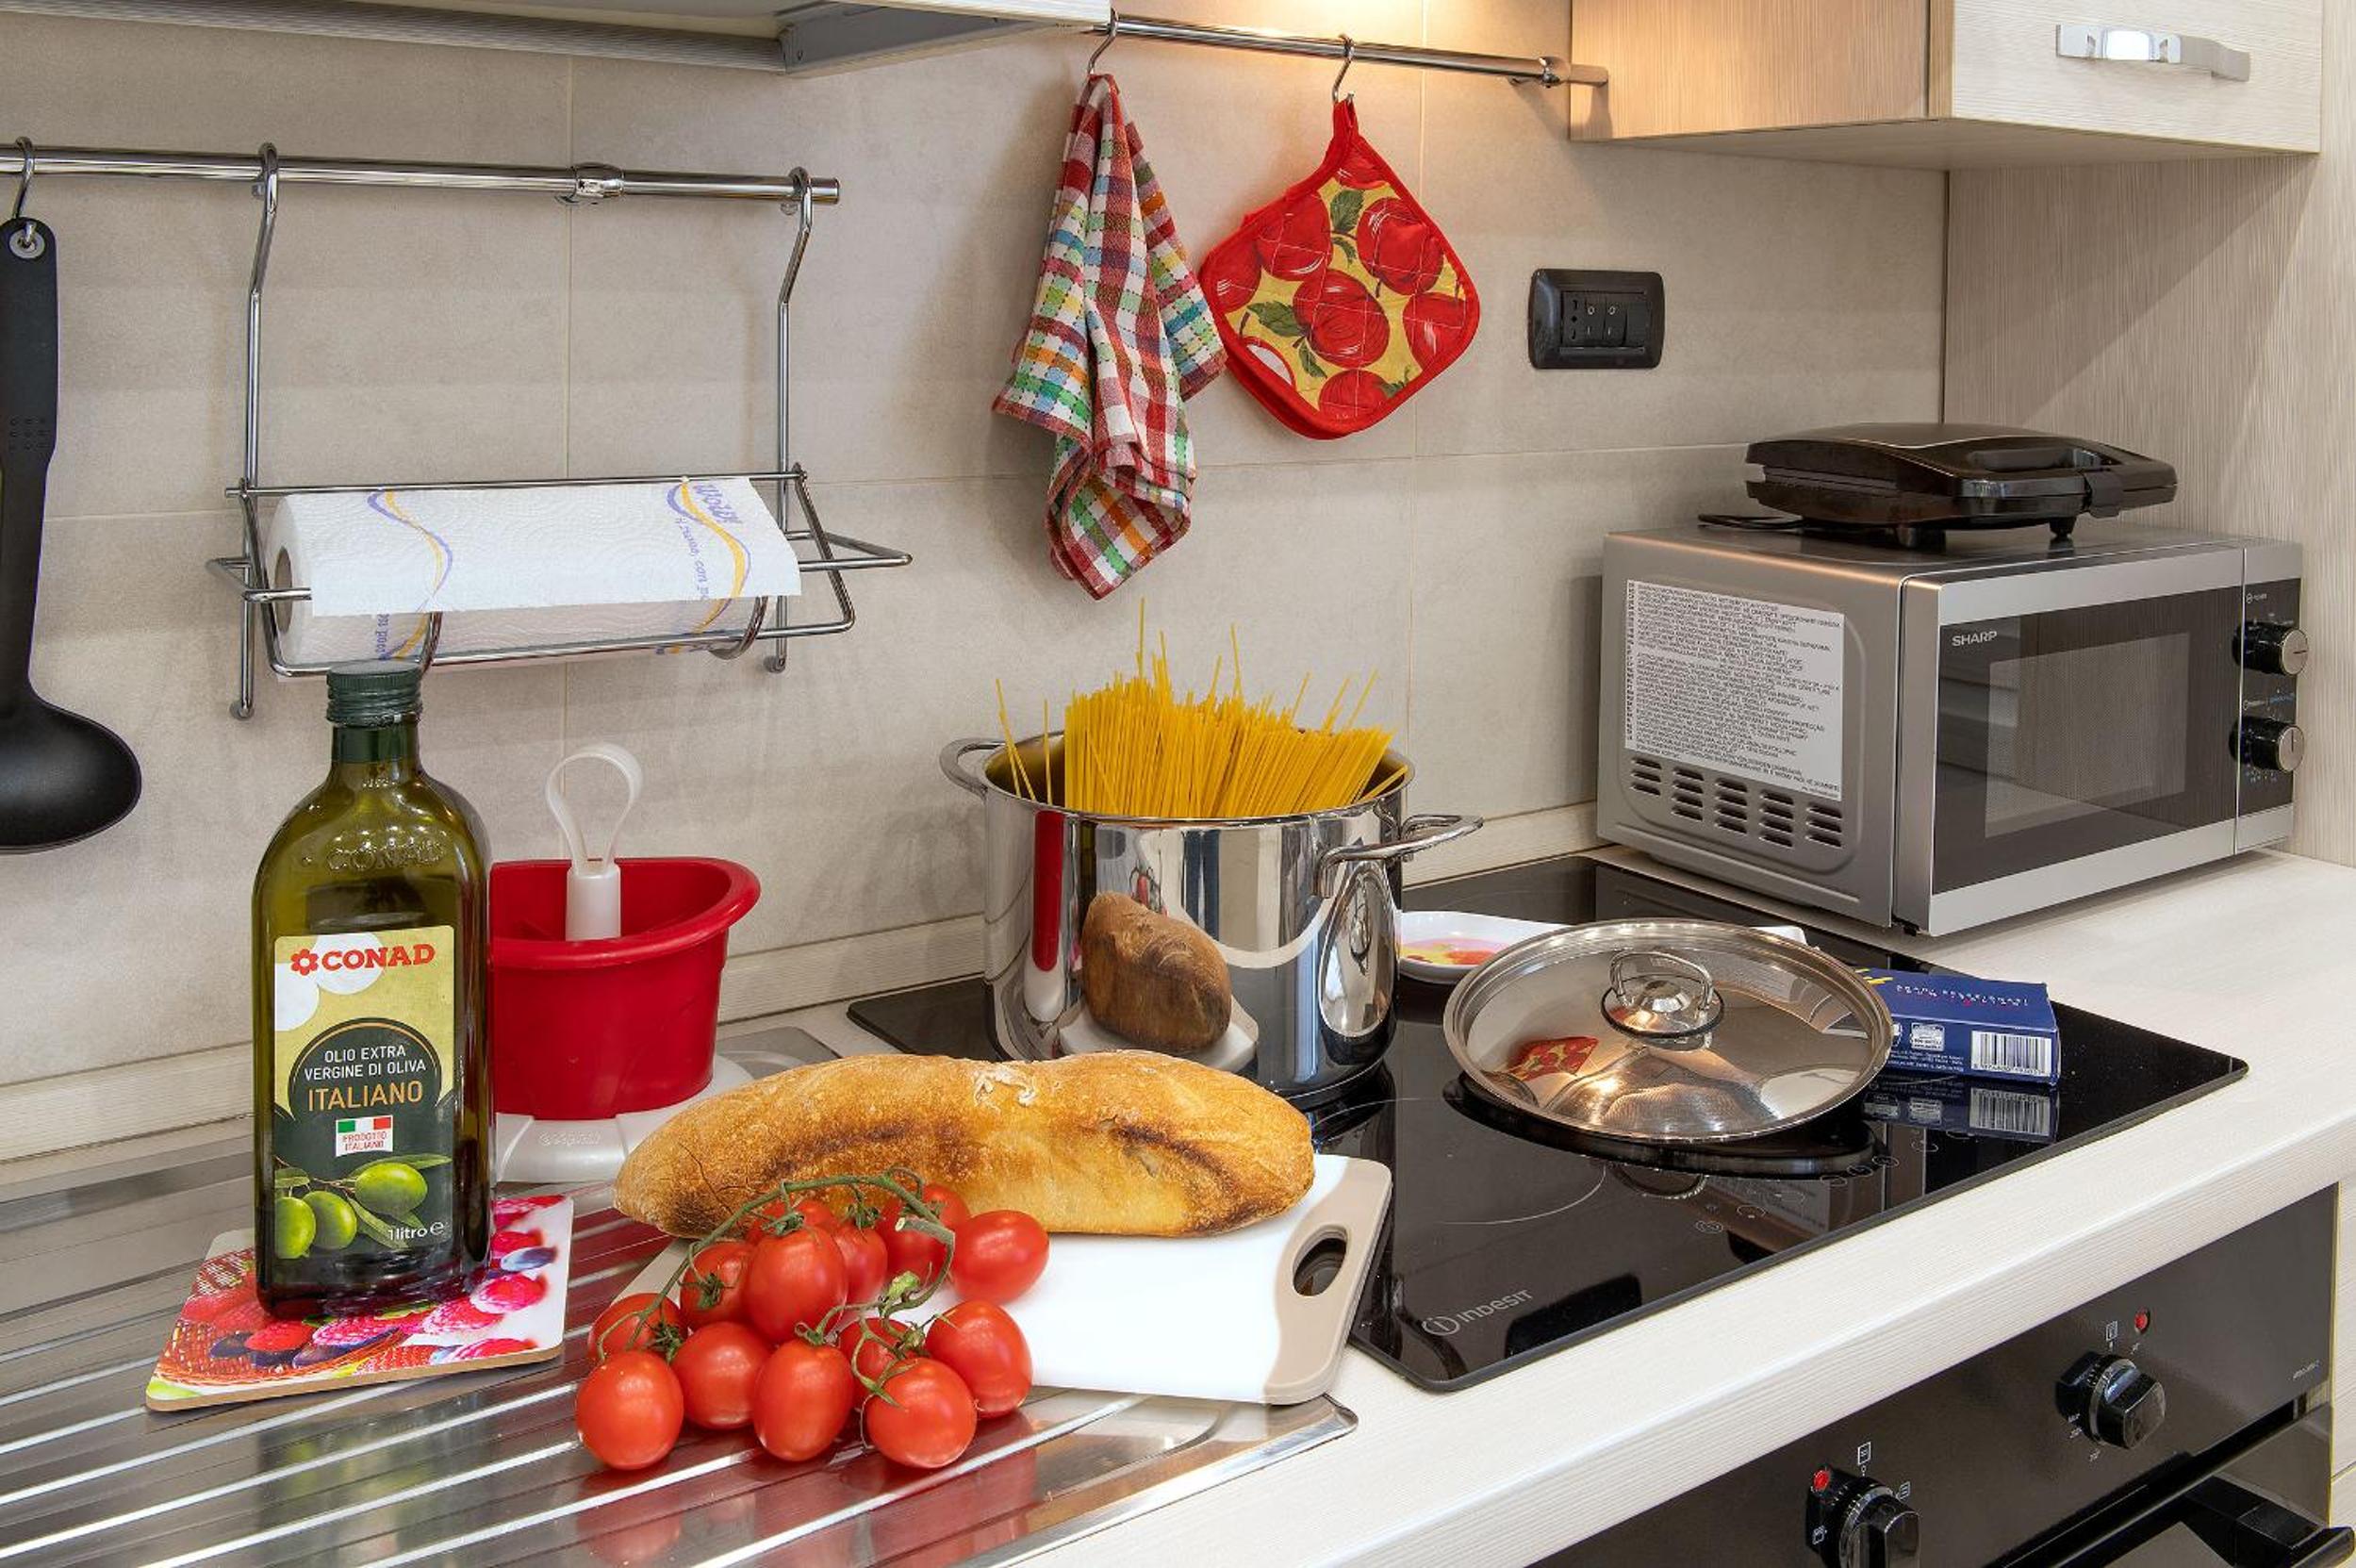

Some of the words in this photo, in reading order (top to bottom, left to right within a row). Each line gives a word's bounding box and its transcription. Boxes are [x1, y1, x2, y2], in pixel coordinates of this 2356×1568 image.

[1952, 630, 1999, 647] SHARP
[321, 943, 436, 972] CONAD
[324, 1048, 356, 1064] OLIO
[361, 1044, 406, 1061] EXTRA
[304, 1064, 364, 1081] VERGINE
[368, 1063, 382, 1077] DI
[387, 1058, 427, 1074] OLIVA
[307, 1080, 423, 1112] ITALIANO
